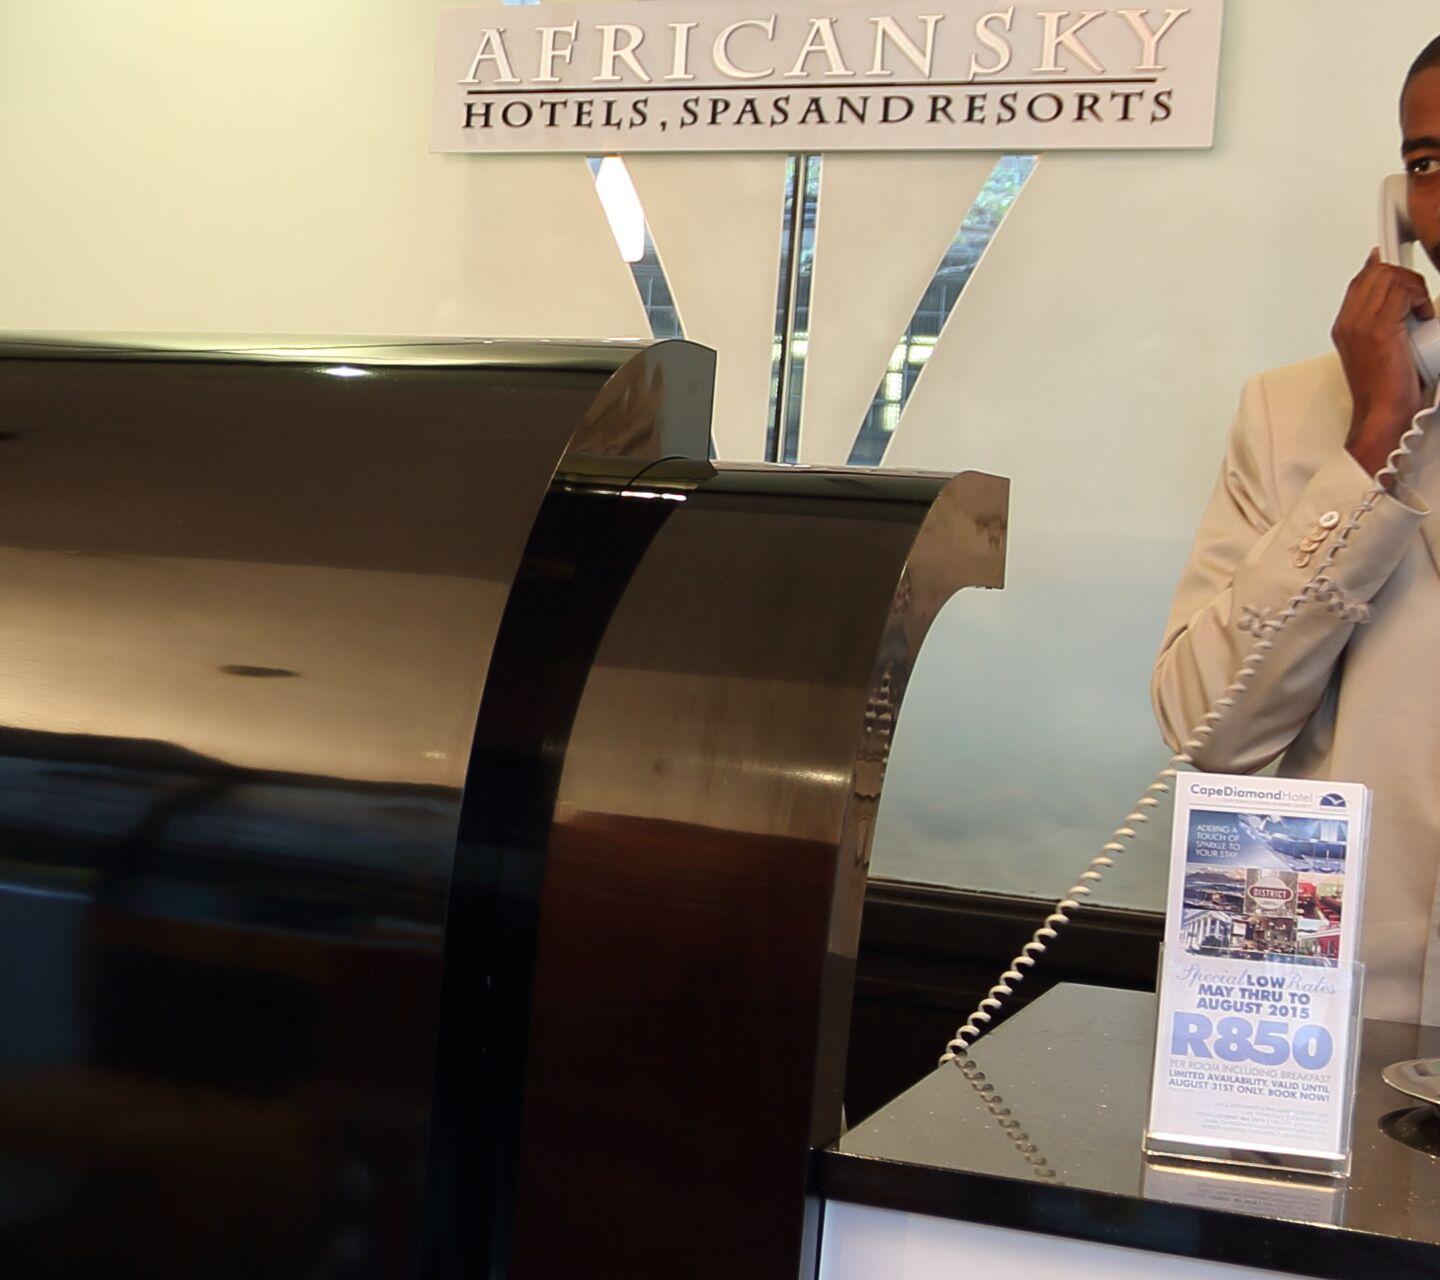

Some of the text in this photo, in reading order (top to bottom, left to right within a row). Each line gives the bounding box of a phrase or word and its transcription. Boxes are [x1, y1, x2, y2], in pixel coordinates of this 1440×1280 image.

[1176, 963, 1336, 995] Special LOW Rates
[1198, 983, 1311, 1005] MAY THRU TO
[1196, 997, 1310, 1019] AUGUST 2015
[1171, 1010, 1334, 1071] R850
[1169, 1069, 1205, 1080] LIMITED
[1271, 1079, 1299, 1090] VALID
[1301, 1083, 1331, 1094] UNTIL
[1221, 1064, 1279, 1079] INCLUDING
[1280, 1070, 1332, 1083] BREAKFAST
[1169, 1078, 1209, 1090] AUGUST
[1268, 1088, 1298, 1100] BOOK
